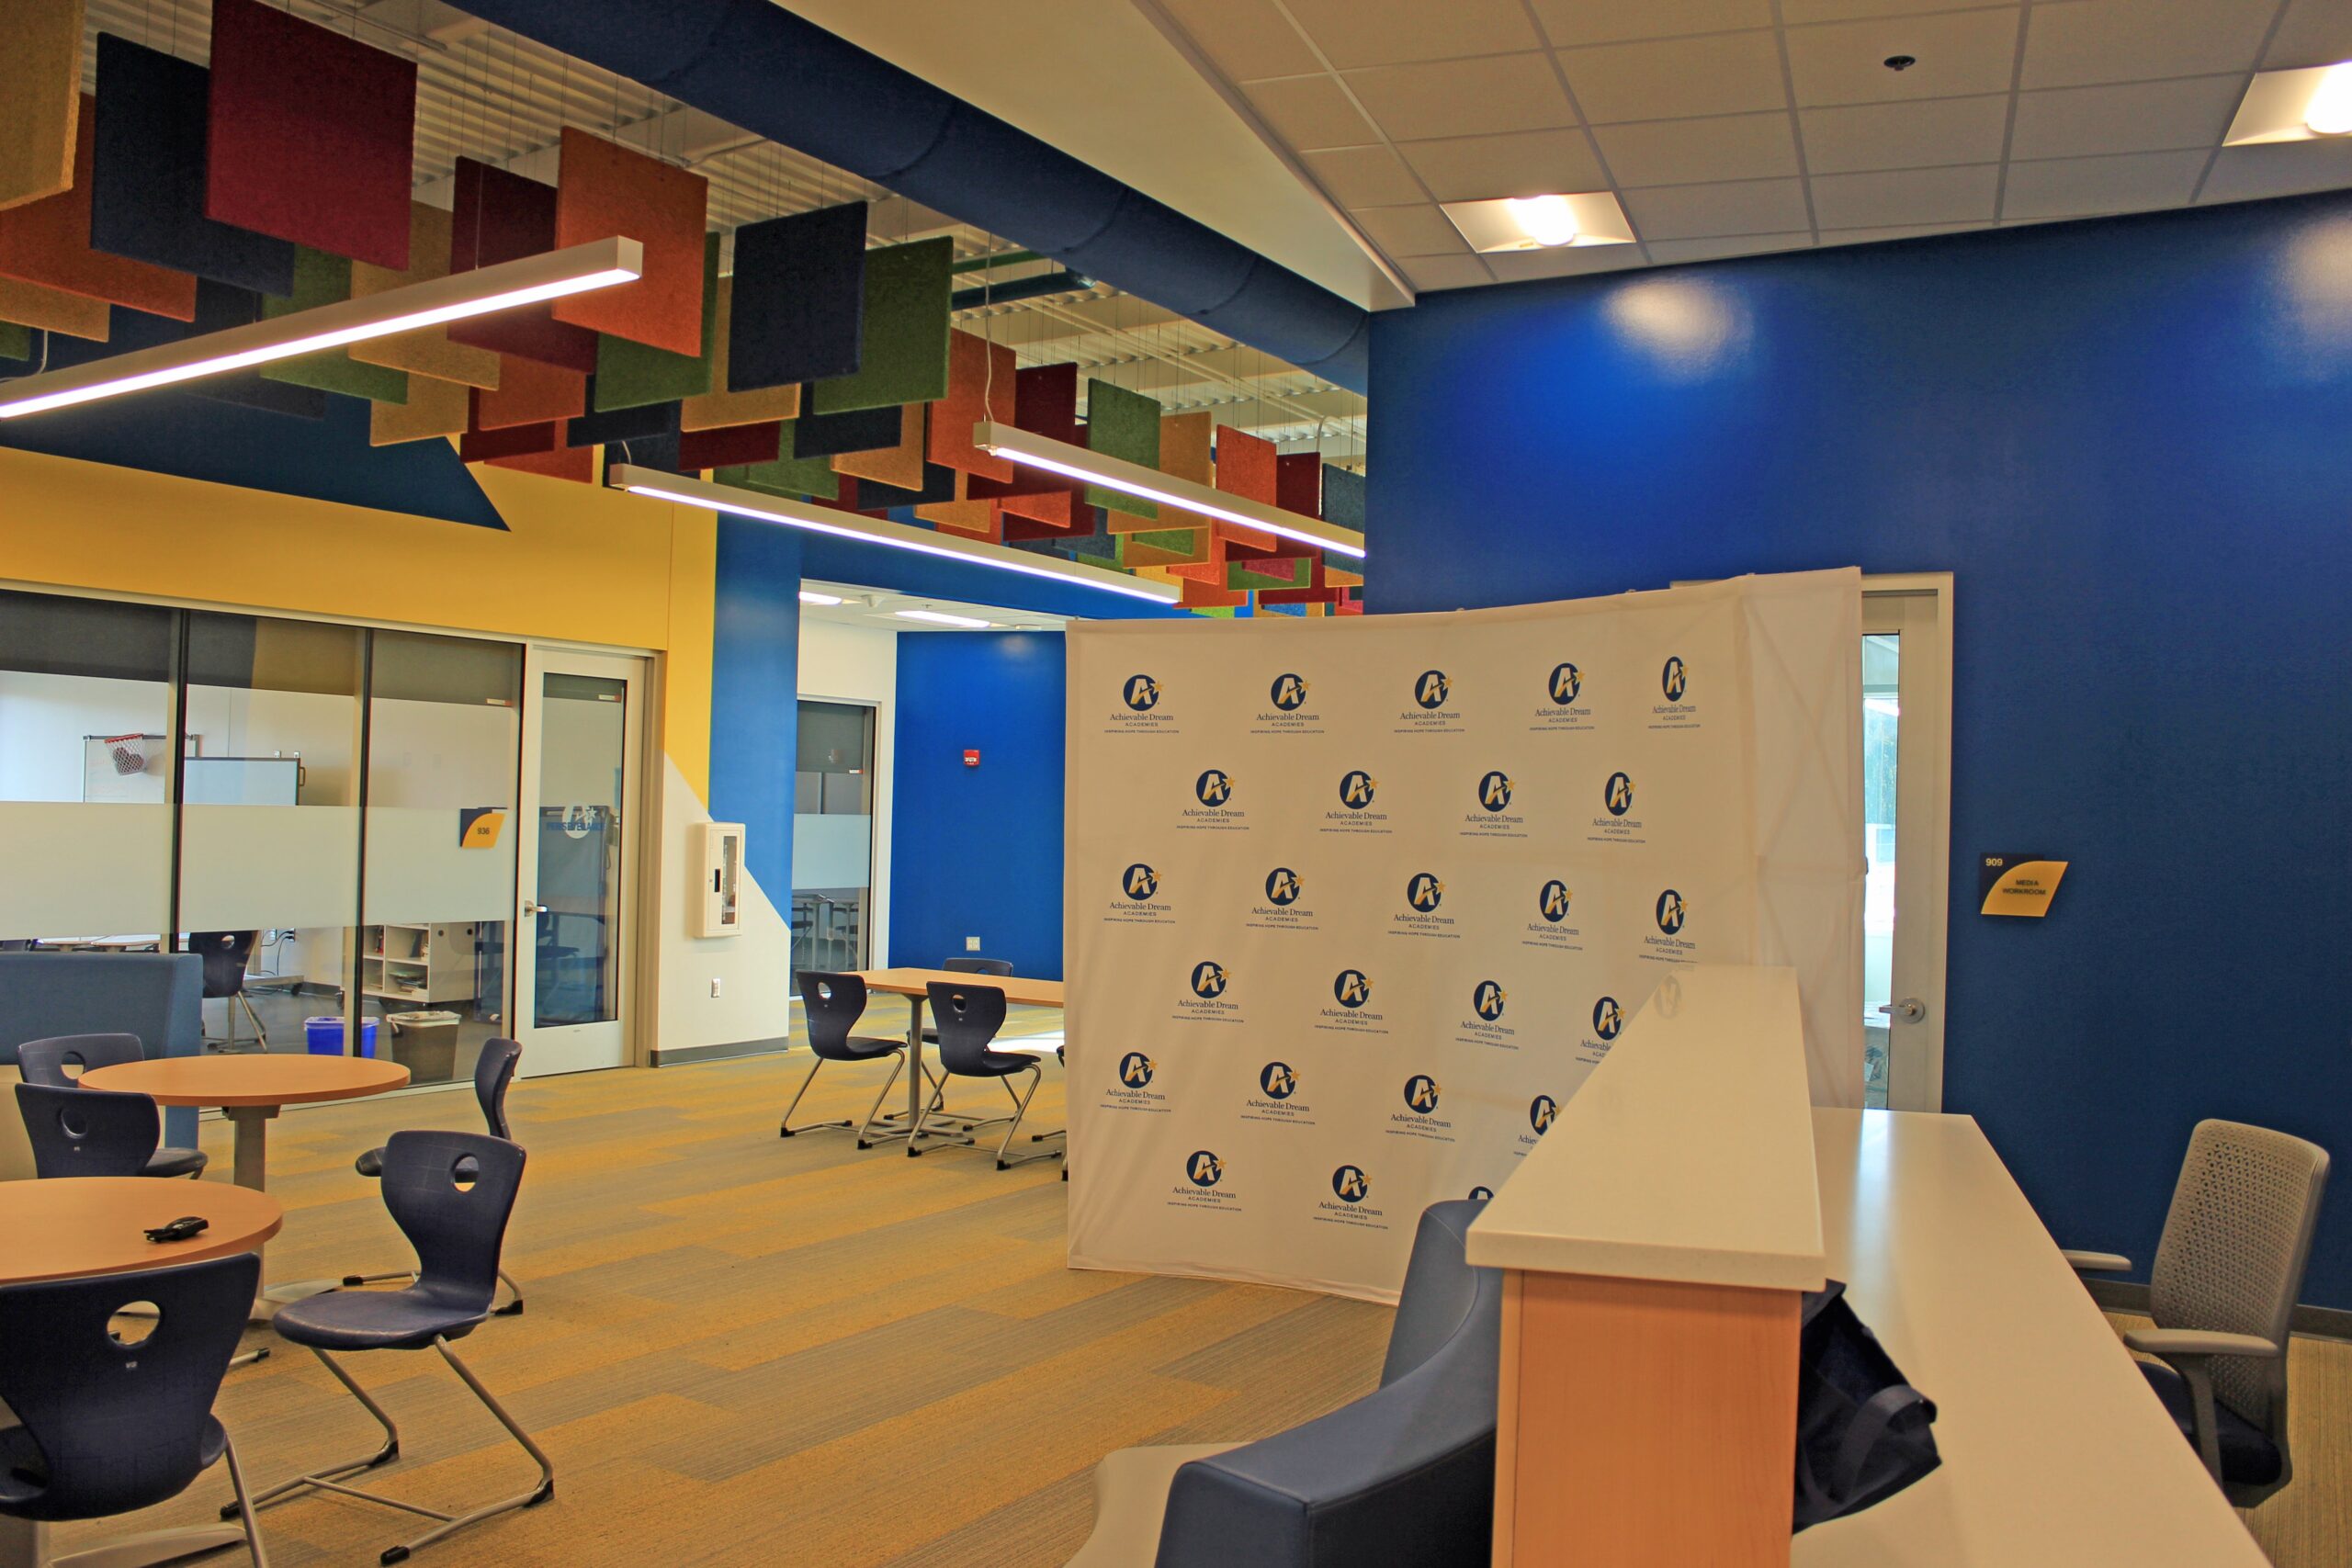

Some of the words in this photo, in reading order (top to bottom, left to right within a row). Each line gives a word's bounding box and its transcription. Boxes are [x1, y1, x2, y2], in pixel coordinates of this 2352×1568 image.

[1535, 707, 1569, 716] Achievable
[1326, 811, 1363, 819] Achievable
[1465, 814, 1500, 822] Achievable
[1985, 858, 2003, 866] 909
[1251, 907, 1288, 915] Achievable
[1290, 908, 1313, 917] Dream
[1394, 914, 1430, 922] Achievable
[1432, 916, 1454, 924] Dream
[1178, 999, 1215, 1008] Achievable
[1216, 1001, 1238, 1010] Dream
[1320, 1009, 1358, 1019] Achievable
[1360, 1011, 1383, 1020] Dream
[1106, 1089, 1142, 1098] Achievable
[1143, 1091, 1165, 1100] Dream
[1247, 1100, 1284, 1109] Achievable
[1286, 1102, 1309, 1111] Dream
[1391, 1113, 1428, 1123] Achievable
[1430, 1118, 1451, 1128] Dream
[1172, 1187, 1210, 1196] Achievable
[1318, 1201, 1357, 1213] Achievable
[1359, 1206, 1382, 1216] Dream
[1334, 1212, 1367, 1220] ACADEMIES
